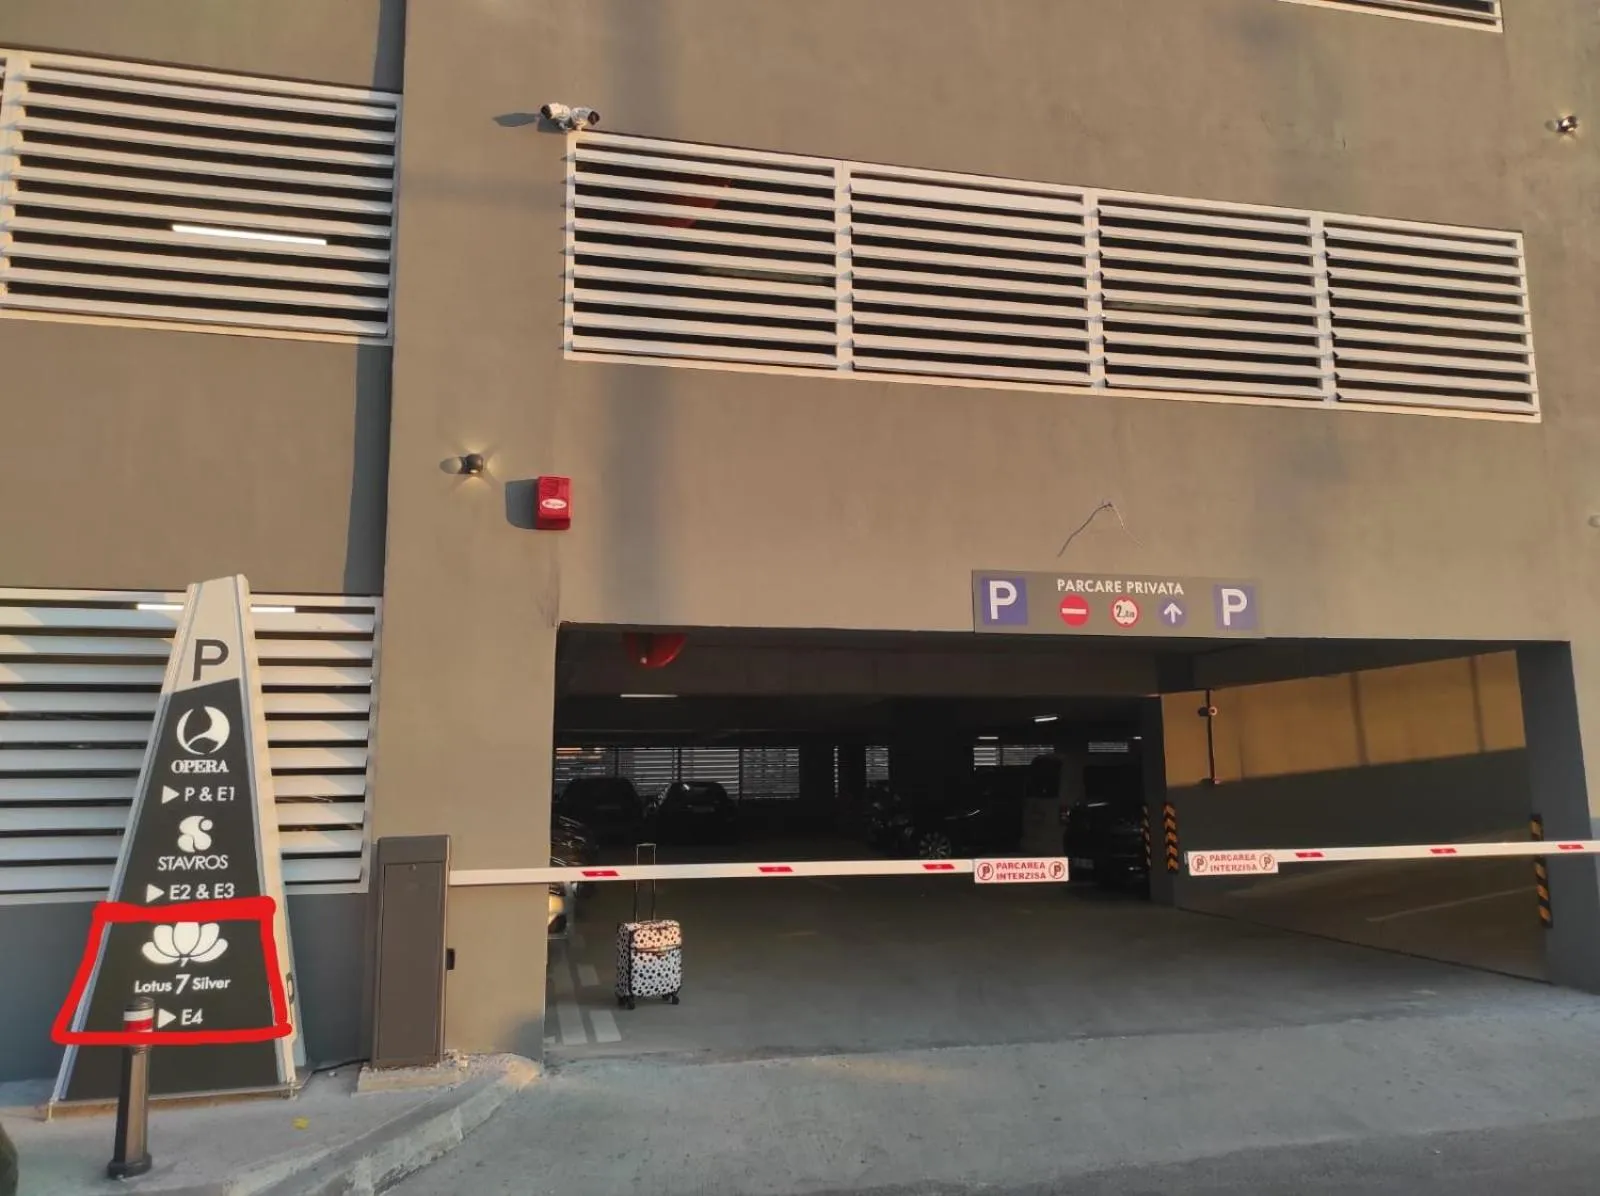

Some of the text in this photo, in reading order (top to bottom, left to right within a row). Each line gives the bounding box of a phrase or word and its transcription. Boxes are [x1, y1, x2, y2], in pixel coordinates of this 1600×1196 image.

[1057, 578, 1184, 595] PARCARE PRIVATA
[989, 580, 1018, 620] P
[1221, 588, 1248, 626] P
[192, 638, 229, 682] P
[171, 759, 229, 774] OPERA
[184, 786, 235, 802] P & E1
[157, 854, 229, 871] STAVROS
[996, 861, 1046, 870] PARCAREA
[1209, 852, 1257, 862] PARCAREA
[996, 872, 1047, 880] INTERZISA
[1210, 863, 1258, 873] INTERZISA
[169, 883, 235, 900] E2 & E3
[134, 973, 231, 995] Lotus 7 Silver
[181, 1008, 203, 1026] E4
